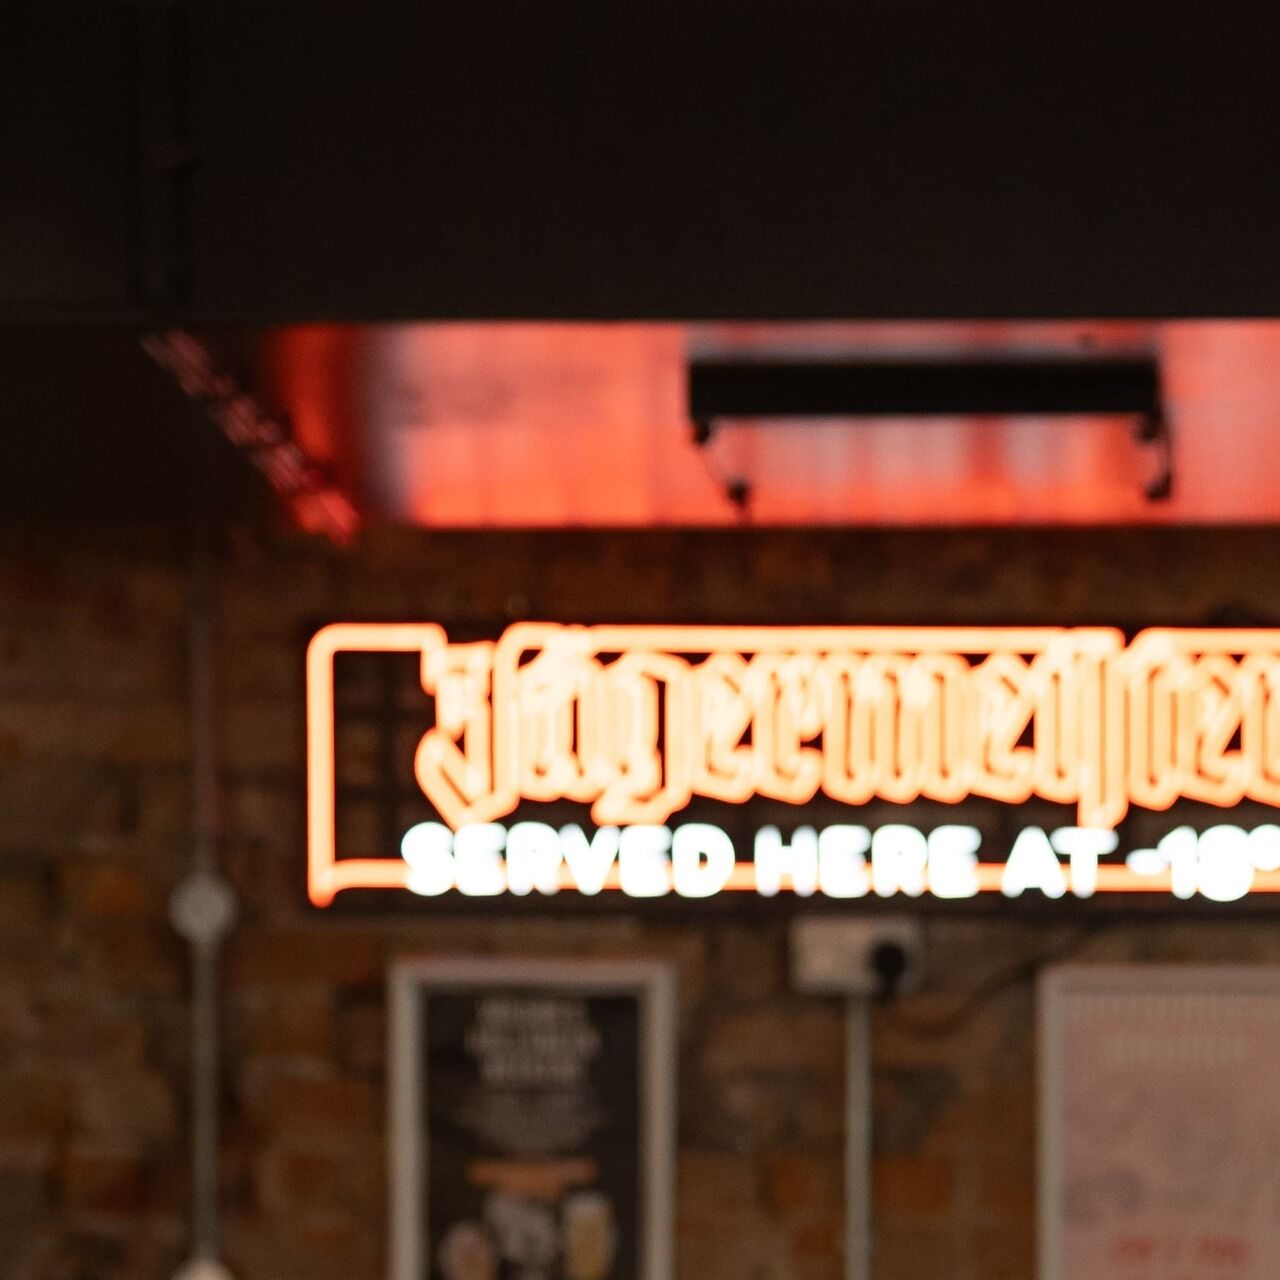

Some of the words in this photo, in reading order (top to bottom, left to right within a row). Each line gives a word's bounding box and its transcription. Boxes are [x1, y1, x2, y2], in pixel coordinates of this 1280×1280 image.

[401, 821, 735, 897] SERVED
[754, 824, 981, 898] HERE
[1001, 826, 1119, 898] AT
